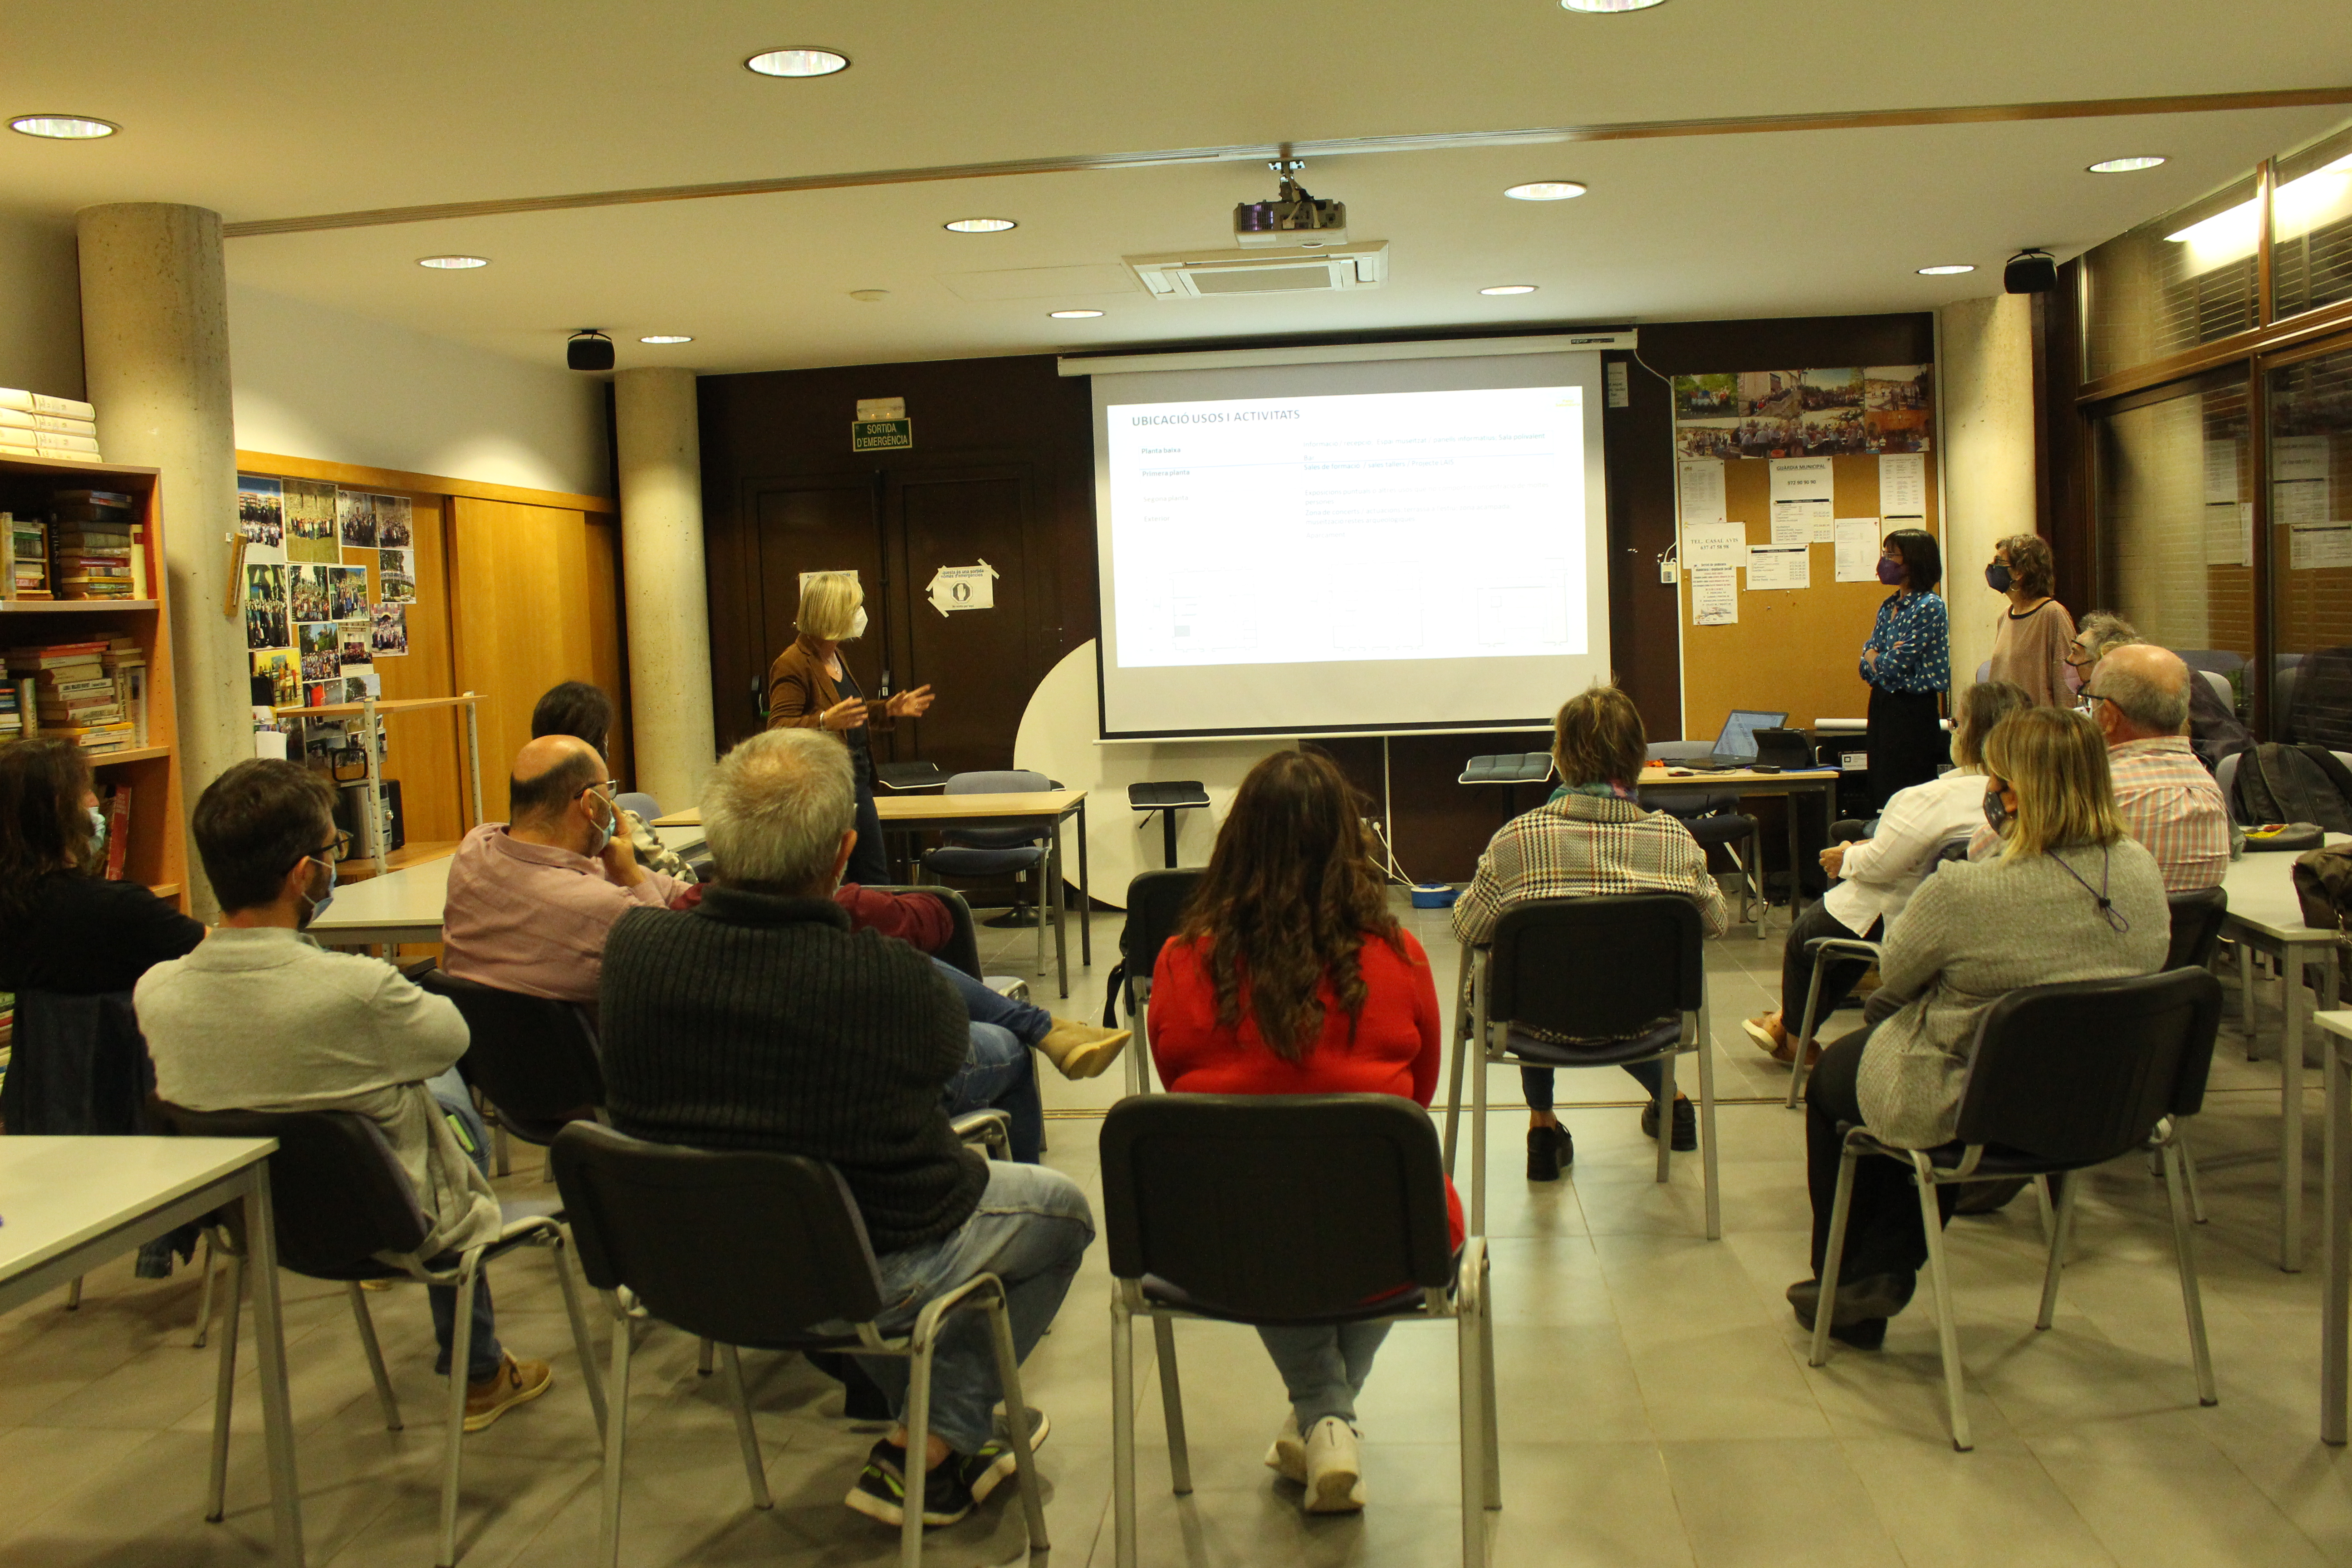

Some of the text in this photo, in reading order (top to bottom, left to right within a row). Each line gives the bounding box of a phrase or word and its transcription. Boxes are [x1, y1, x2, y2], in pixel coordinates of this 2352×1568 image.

[1132, 410, 1300, 426] UBICACIÓ USOS I ACTIVITATS
[857, 423, 908, 447] SORTIDA D'EMERGÈNCIA
